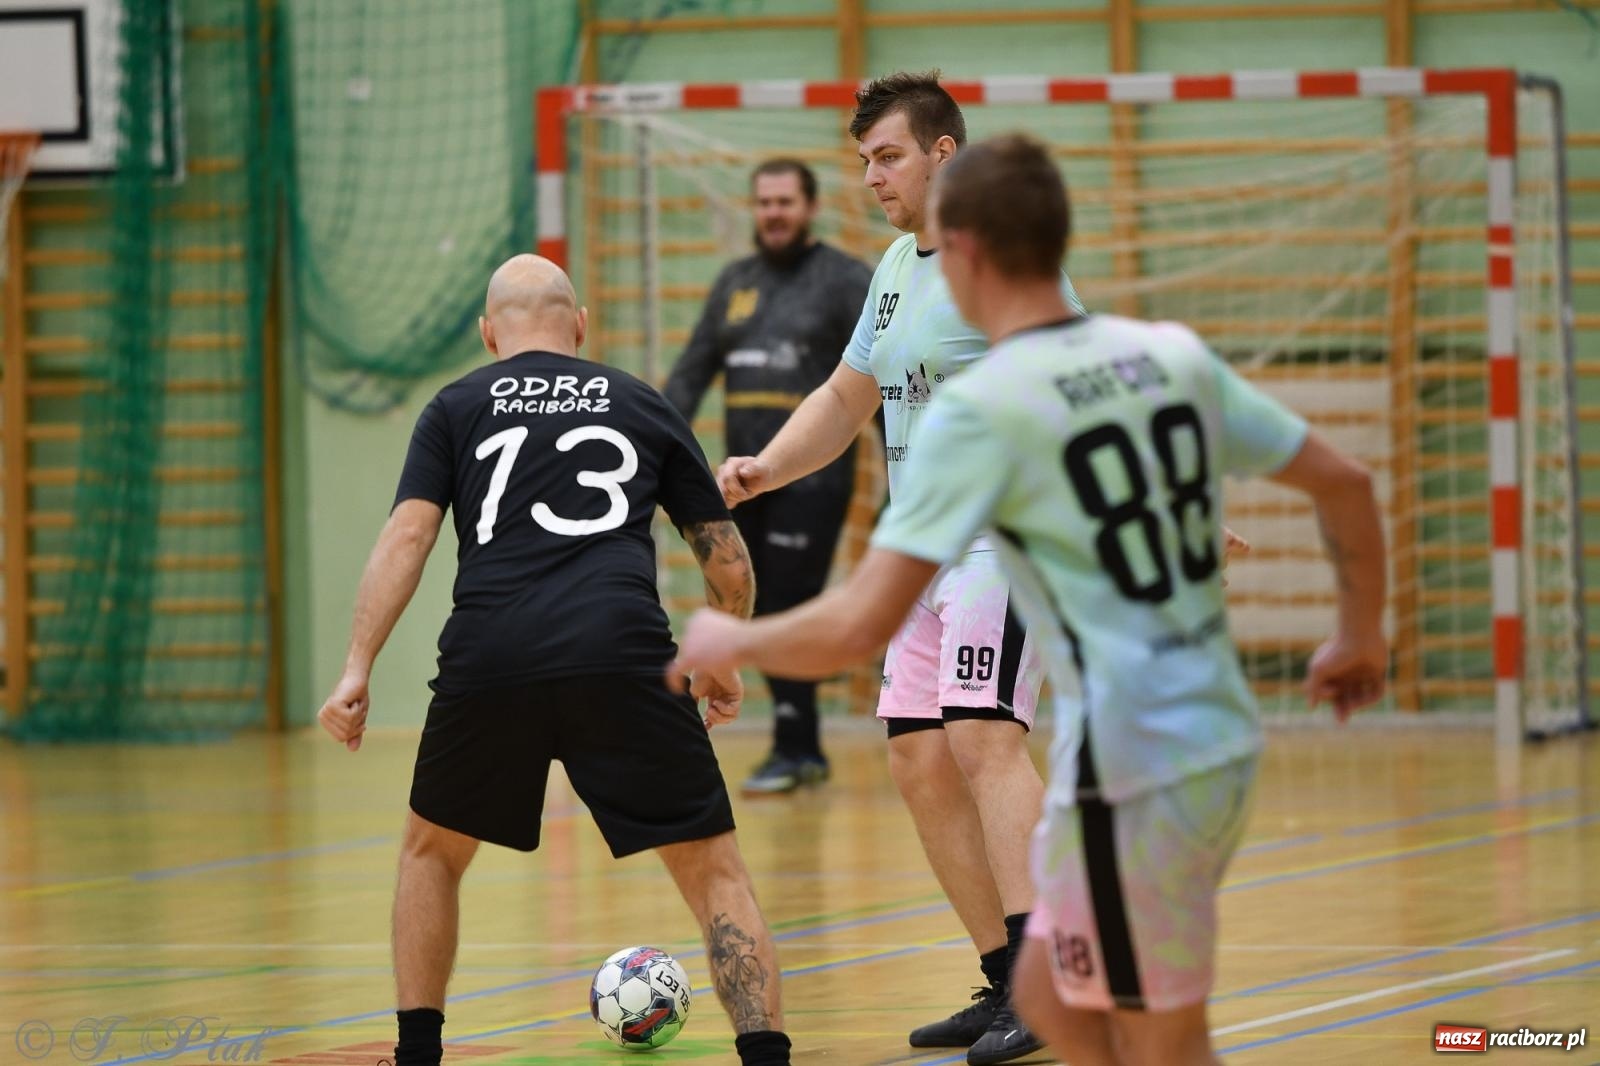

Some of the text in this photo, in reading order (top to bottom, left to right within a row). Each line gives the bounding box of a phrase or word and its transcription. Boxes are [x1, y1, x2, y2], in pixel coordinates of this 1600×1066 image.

[875, 293, 900, 331] 99
[490, 376, 609, 397] ODRA
[493, 396, 611, 415] RACIBÓRZ
[475, 425, 638, 545] 13
[1063, 404, 1218, 604] 88
[956, 645, 995, 680] 99
